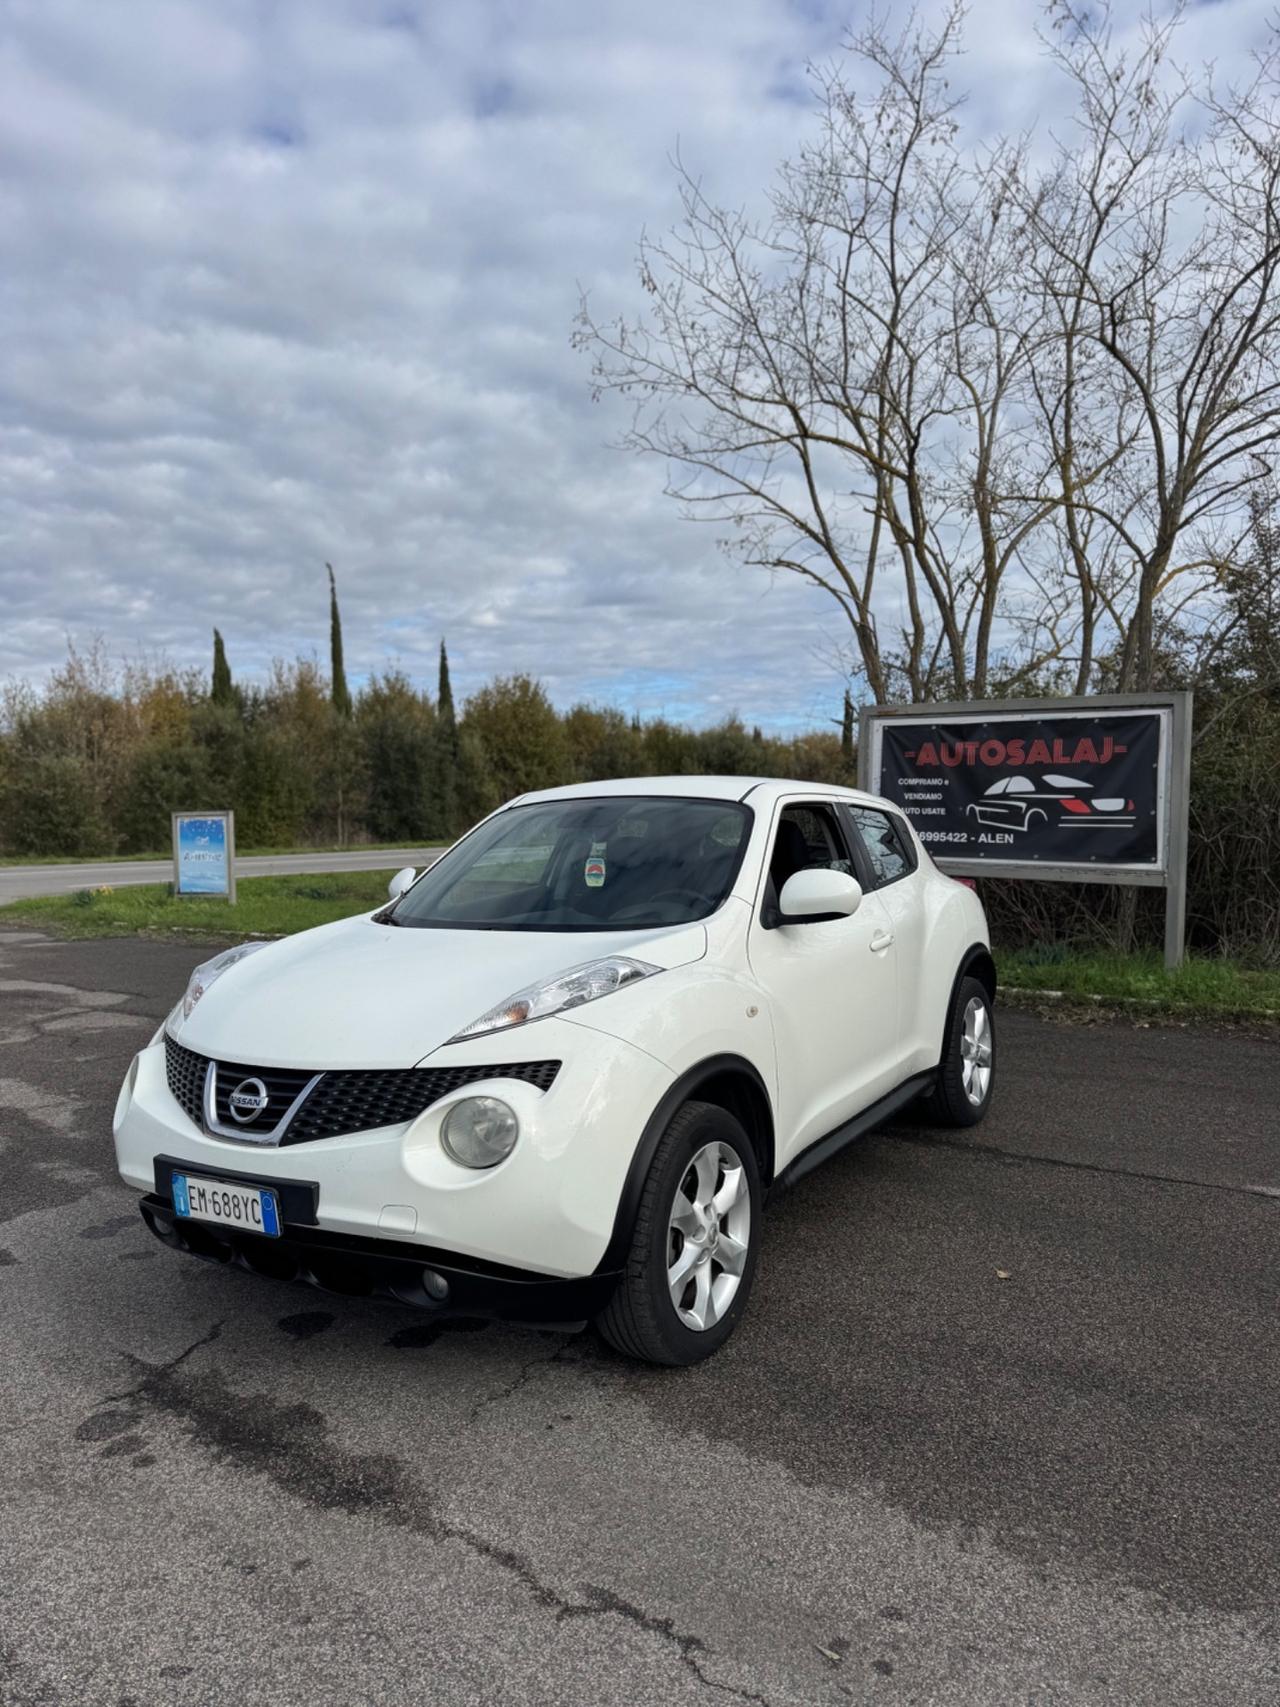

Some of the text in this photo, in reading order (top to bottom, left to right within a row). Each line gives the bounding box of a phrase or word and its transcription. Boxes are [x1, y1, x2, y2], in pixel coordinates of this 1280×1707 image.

[898, 778, 943, 786] COMPRIAMO
[904, 793, 943, 801] VENDIAMO
[921, 807, 946, 816] USATE
[978, 833, 1014, 844] ALEN
